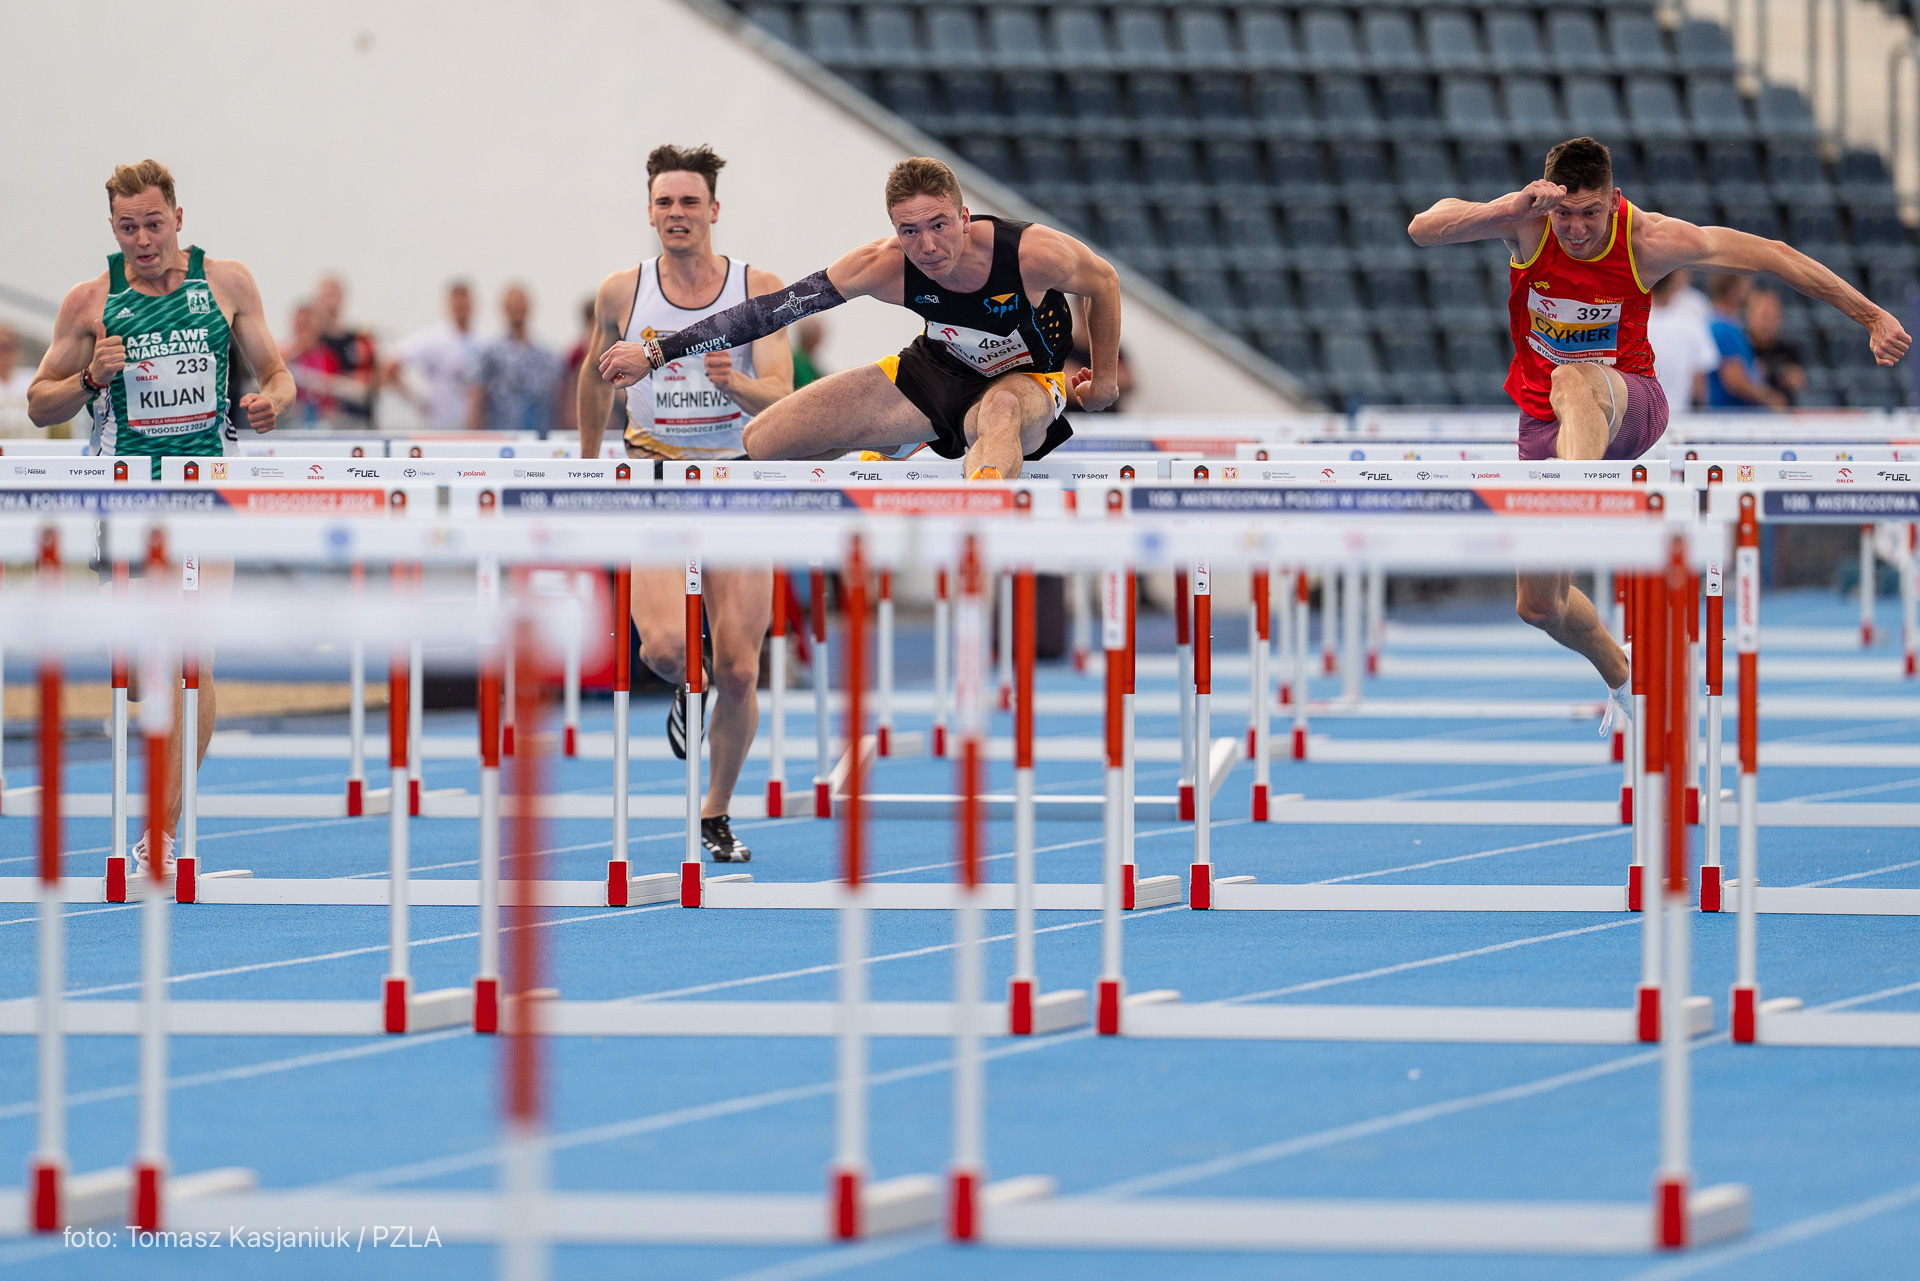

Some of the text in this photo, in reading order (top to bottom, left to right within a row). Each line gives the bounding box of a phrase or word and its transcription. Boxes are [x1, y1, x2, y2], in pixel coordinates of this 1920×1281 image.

[983, 293, 1019, 318] Sopot
[1537, 307, 1557, 320] ORLEN
[1577, 307, 1612, 320] 397
[1535, 316, 1610, 344] CZYKIER
[126, 328, 208, 348] AZS AWF
[685, 333, 726, 355] LUXURY
[127, 340, 209, 360] WARSZAWA
[176, 357, 208, 375] 233
[139, 386, 205, 409] KILJAN
[141, 422, 207, 435] BYDGOSZCZ 2024
[355, 469, 380, 478] FUEL
[583, 471, 604, 479] SPORT
[858, 473, 883, 481] FUEL
[1368, 473, 1393, 481] FUEL
[1885, 473, 1911, 481] FUEL
